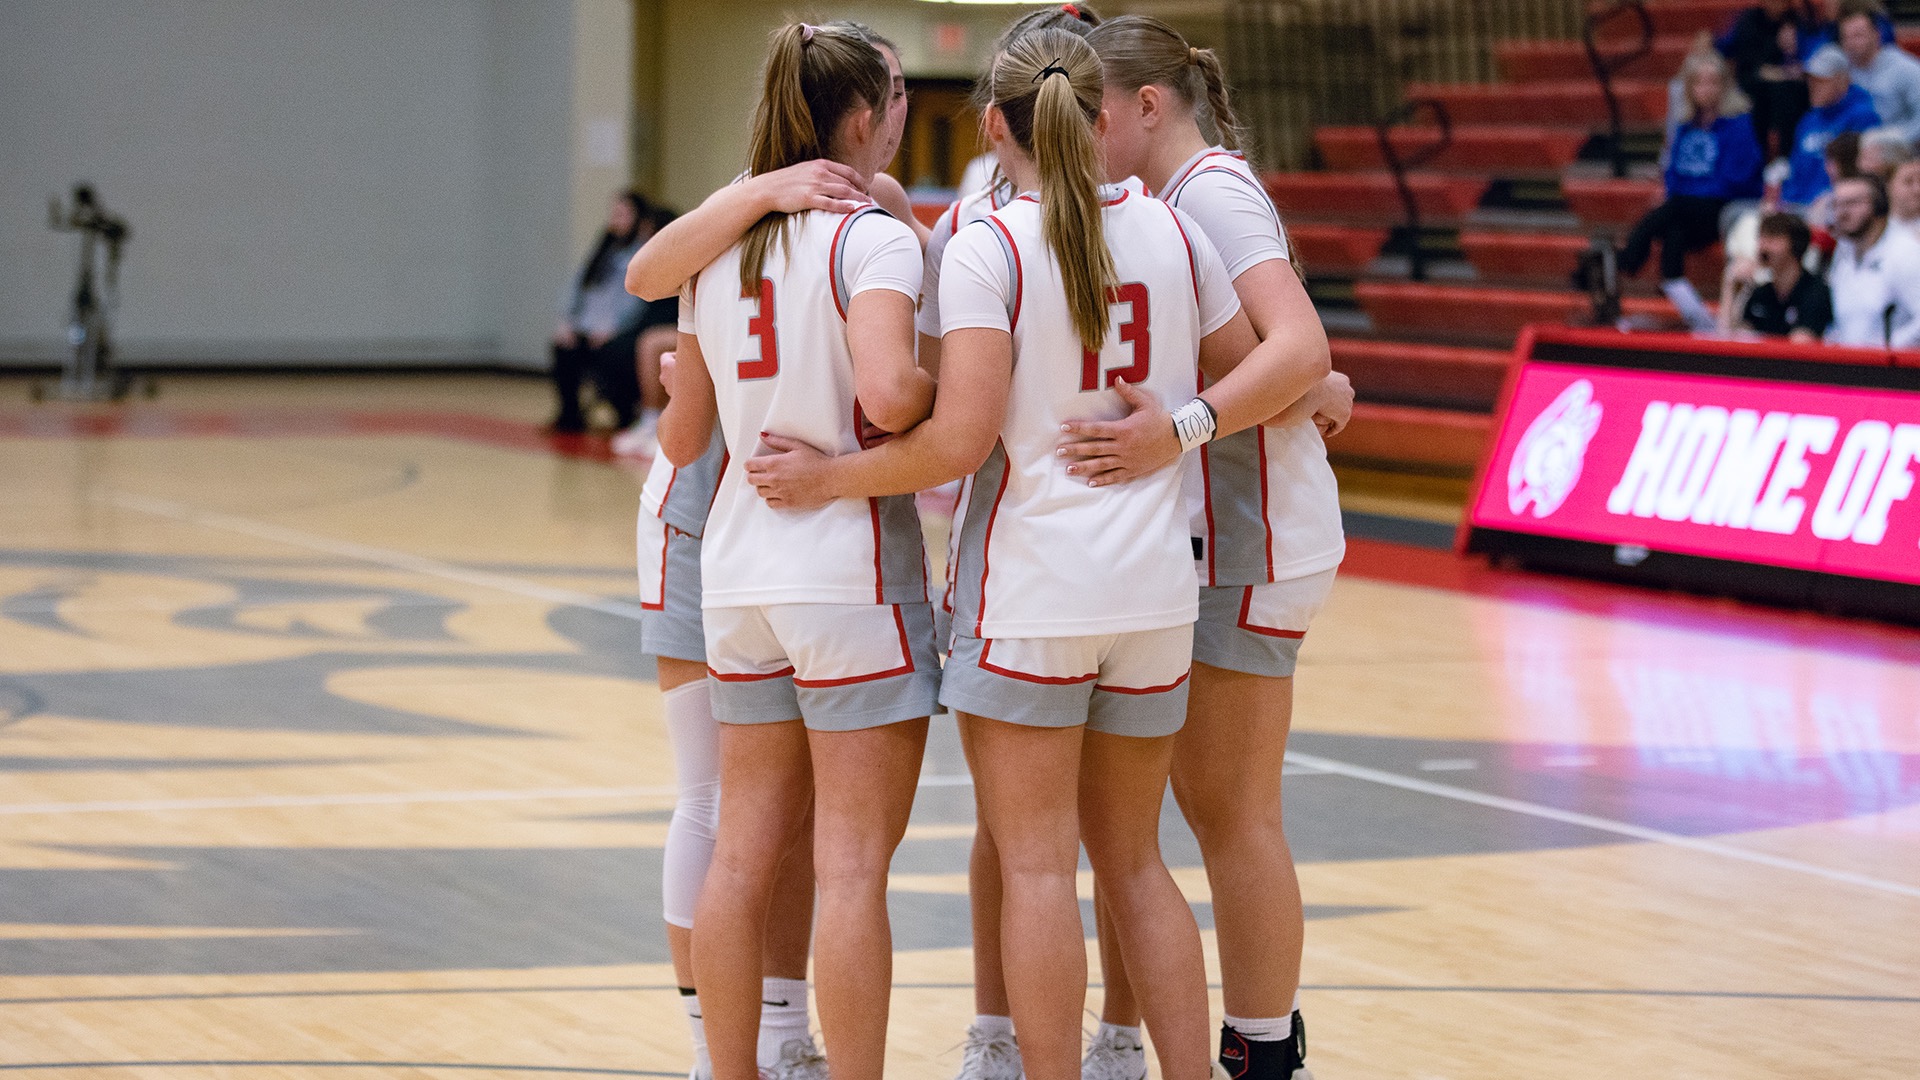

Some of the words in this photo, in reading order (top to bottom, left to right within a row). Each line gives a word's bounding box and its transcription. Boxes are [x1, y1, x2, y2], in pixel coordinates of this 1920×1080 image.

[736, 276, 780, 382] 3
[1607, 401, 1839, 535] HOME
[1811, 419, 1920, 545] OF
